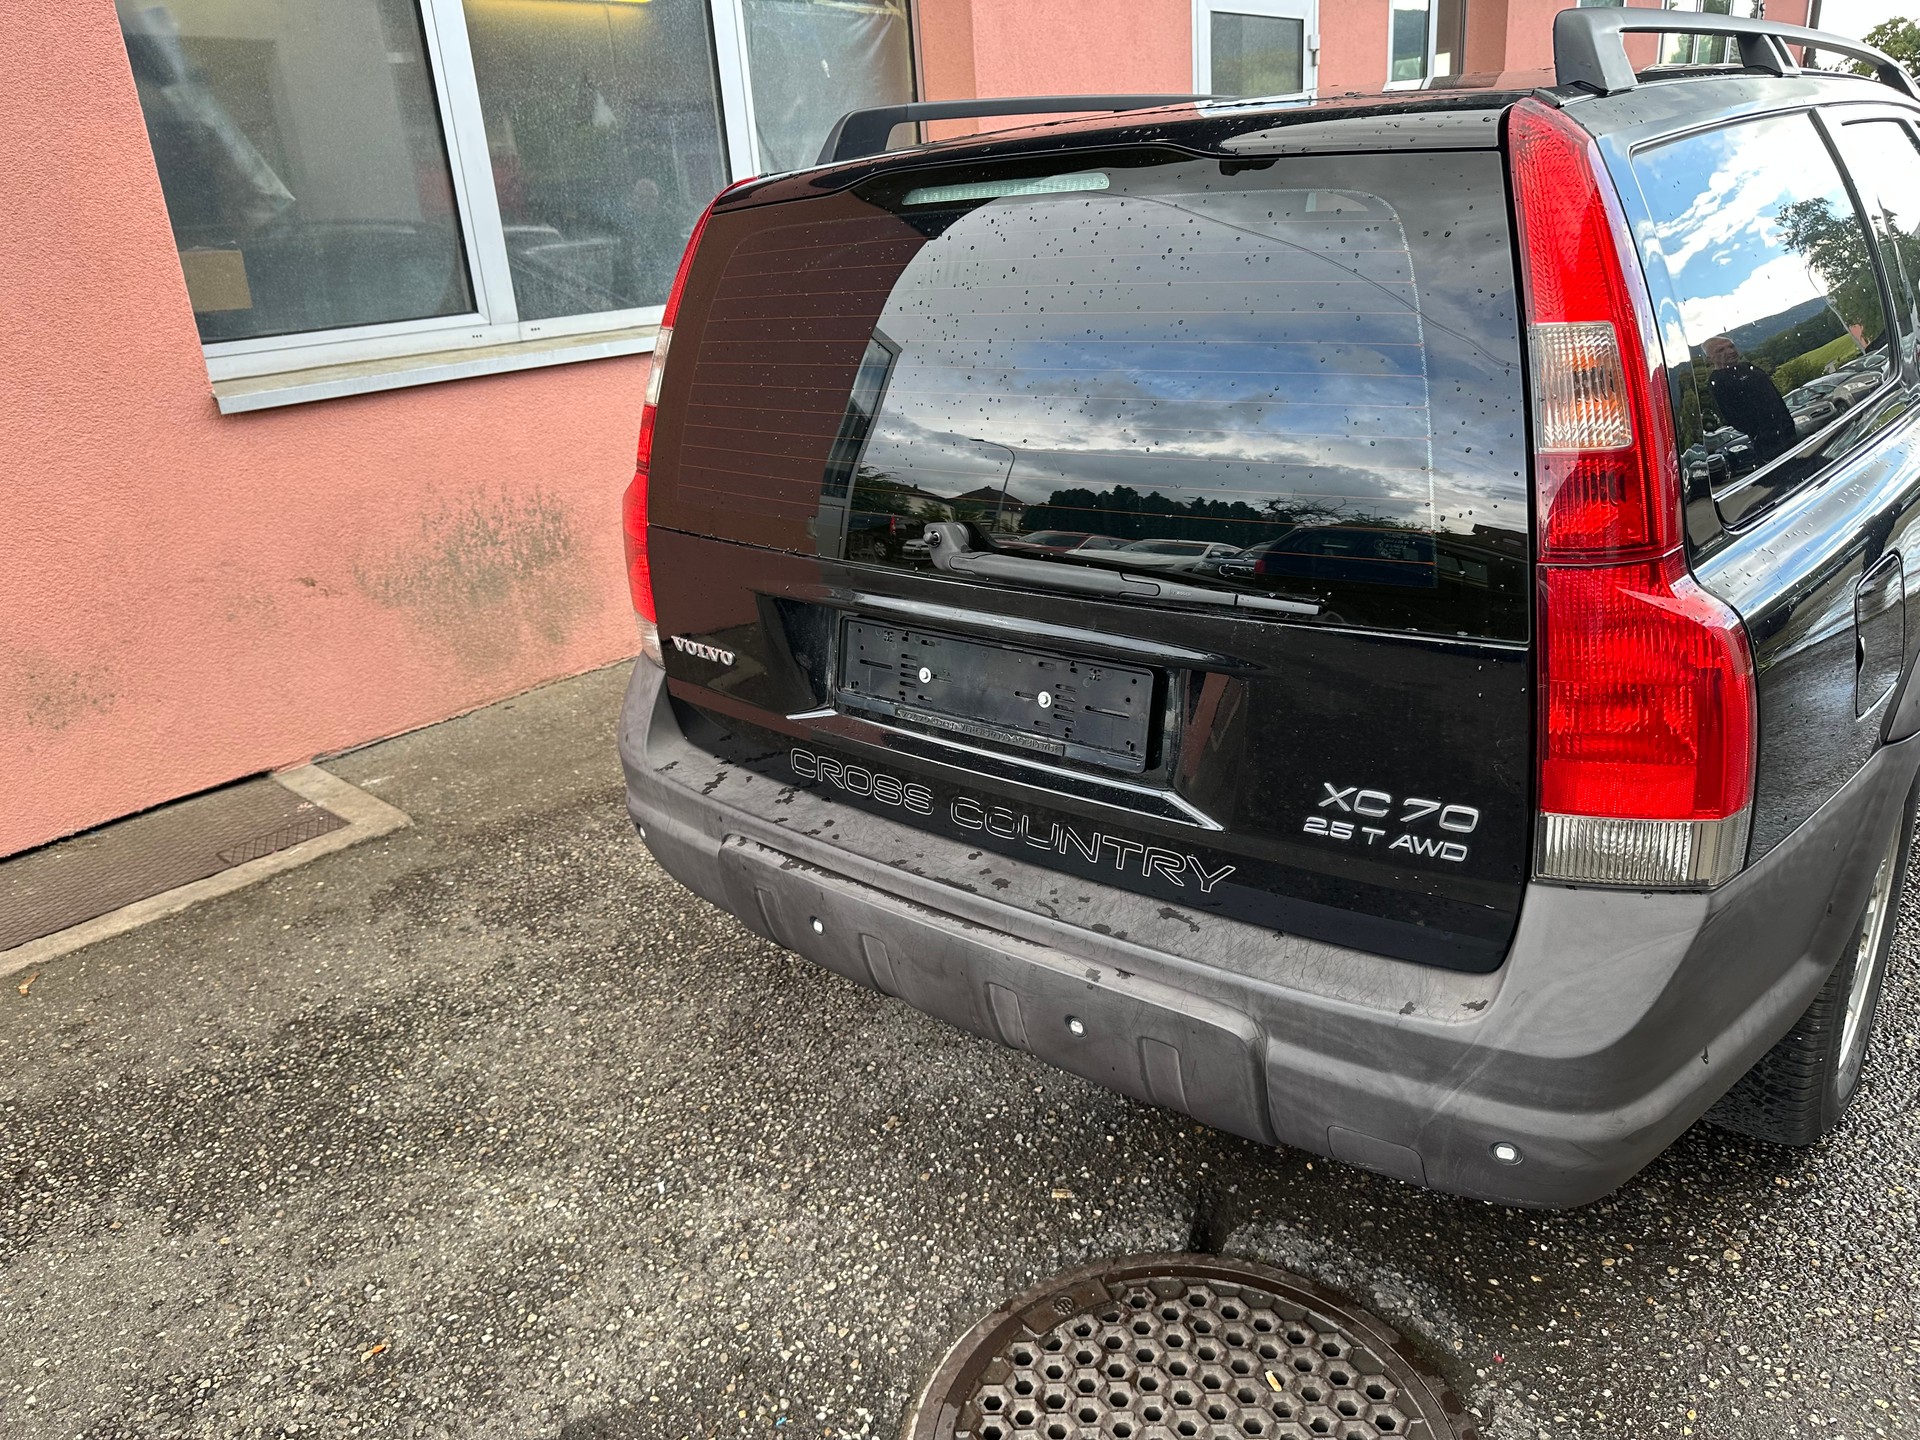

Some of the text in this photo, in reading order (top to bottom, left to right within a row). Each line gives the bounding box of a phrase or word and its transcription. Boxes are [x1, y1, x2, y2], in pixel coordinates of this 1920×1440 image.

[669, 635, 735, 666] VOLVO
[790, 747, 1237, 893] CROSS COUNTRY
[1318, 782, 1480, 834] XC 70
[1303, 816, 1468, 862] 2.5 T AWD
